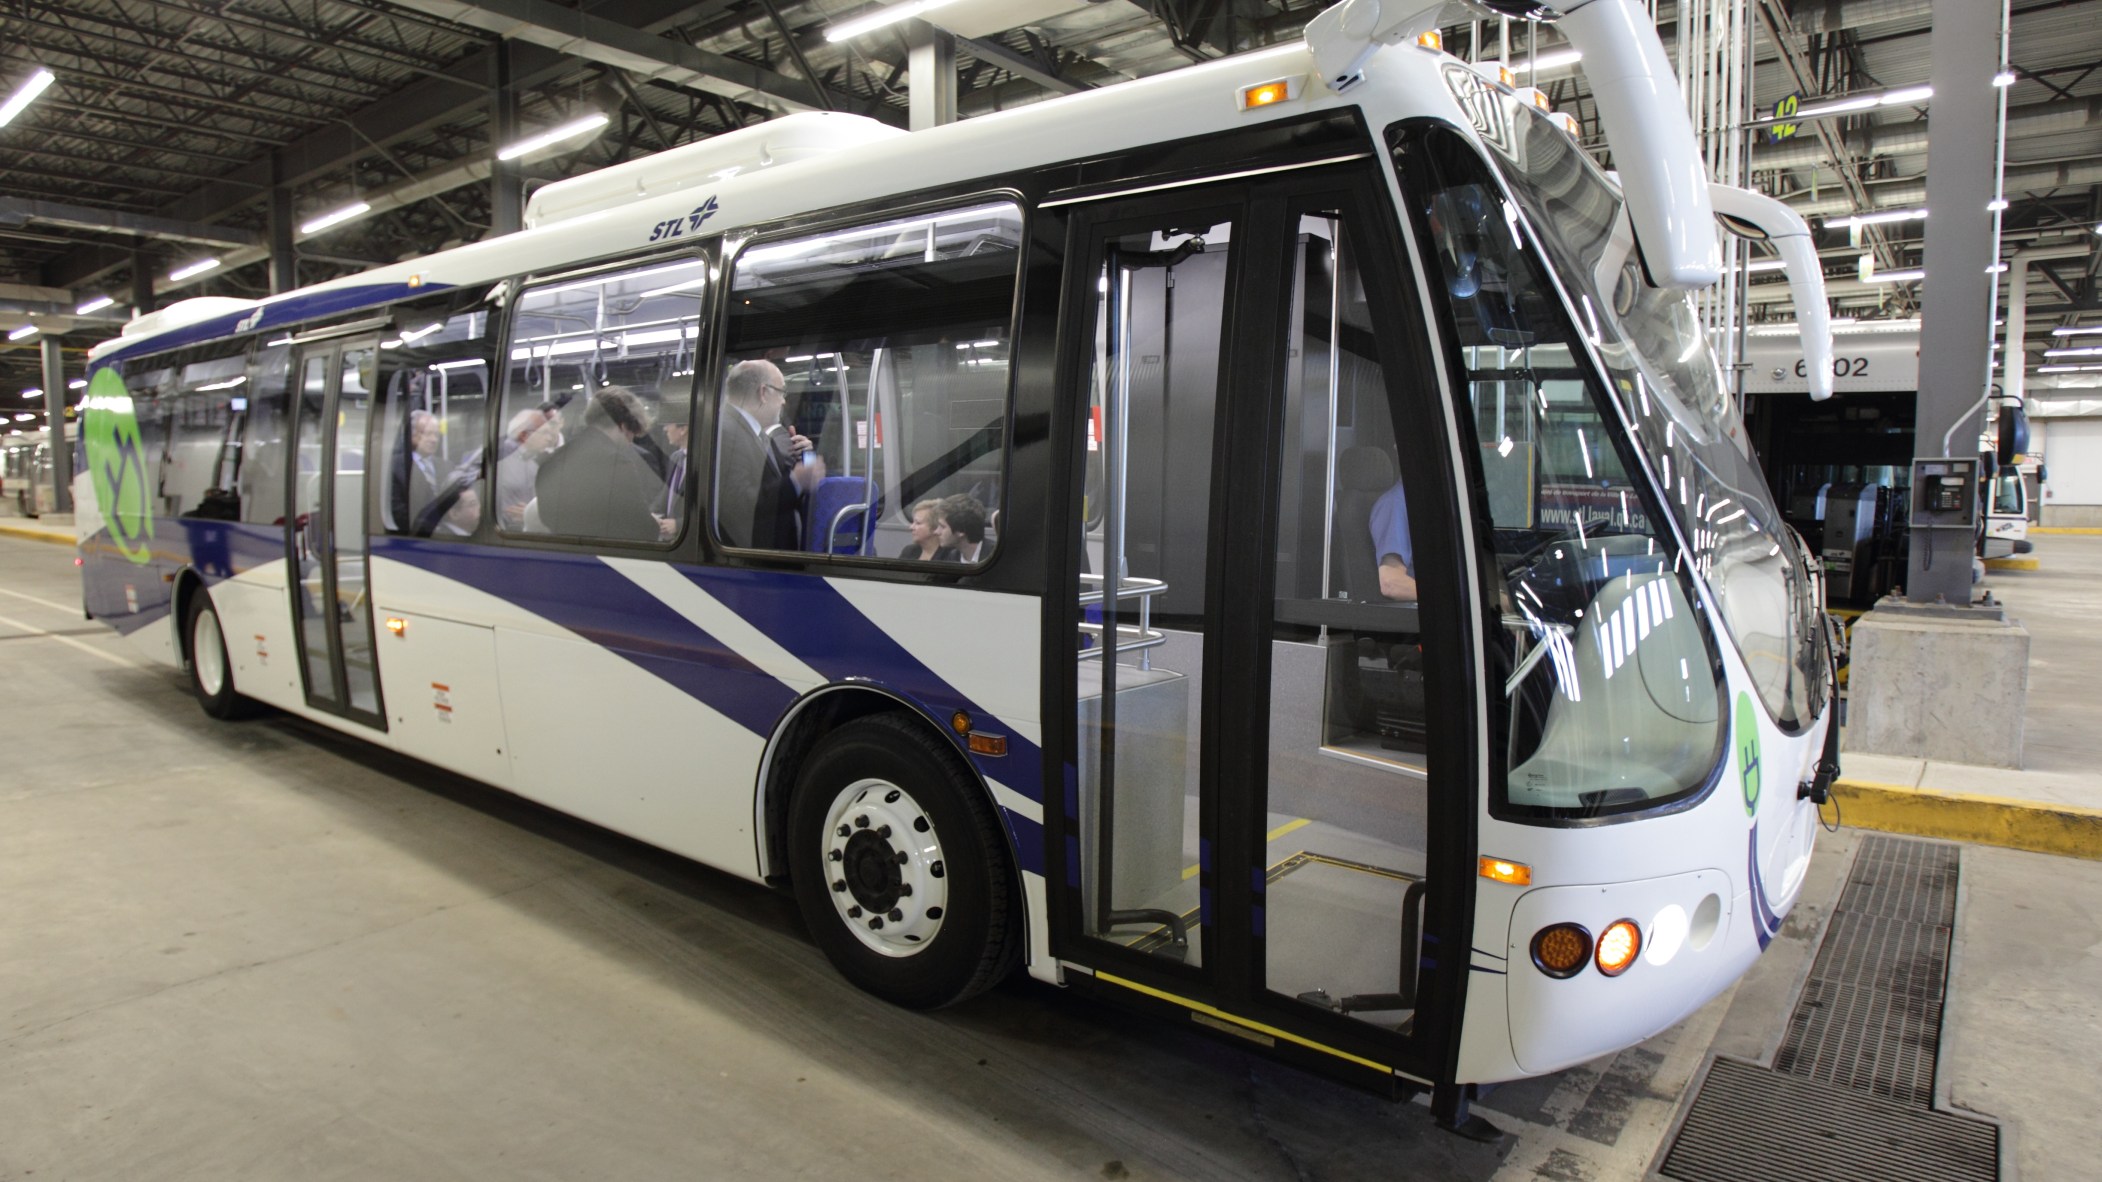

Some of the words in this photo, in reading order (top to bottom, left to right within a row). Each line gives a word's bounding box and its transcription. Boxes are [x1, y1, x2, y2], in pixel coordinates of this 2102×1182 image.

[1772, 95, 1797, 140] 42
[649, 217, 685, 241] STL
[1795, 357, 1868, 378] 602
